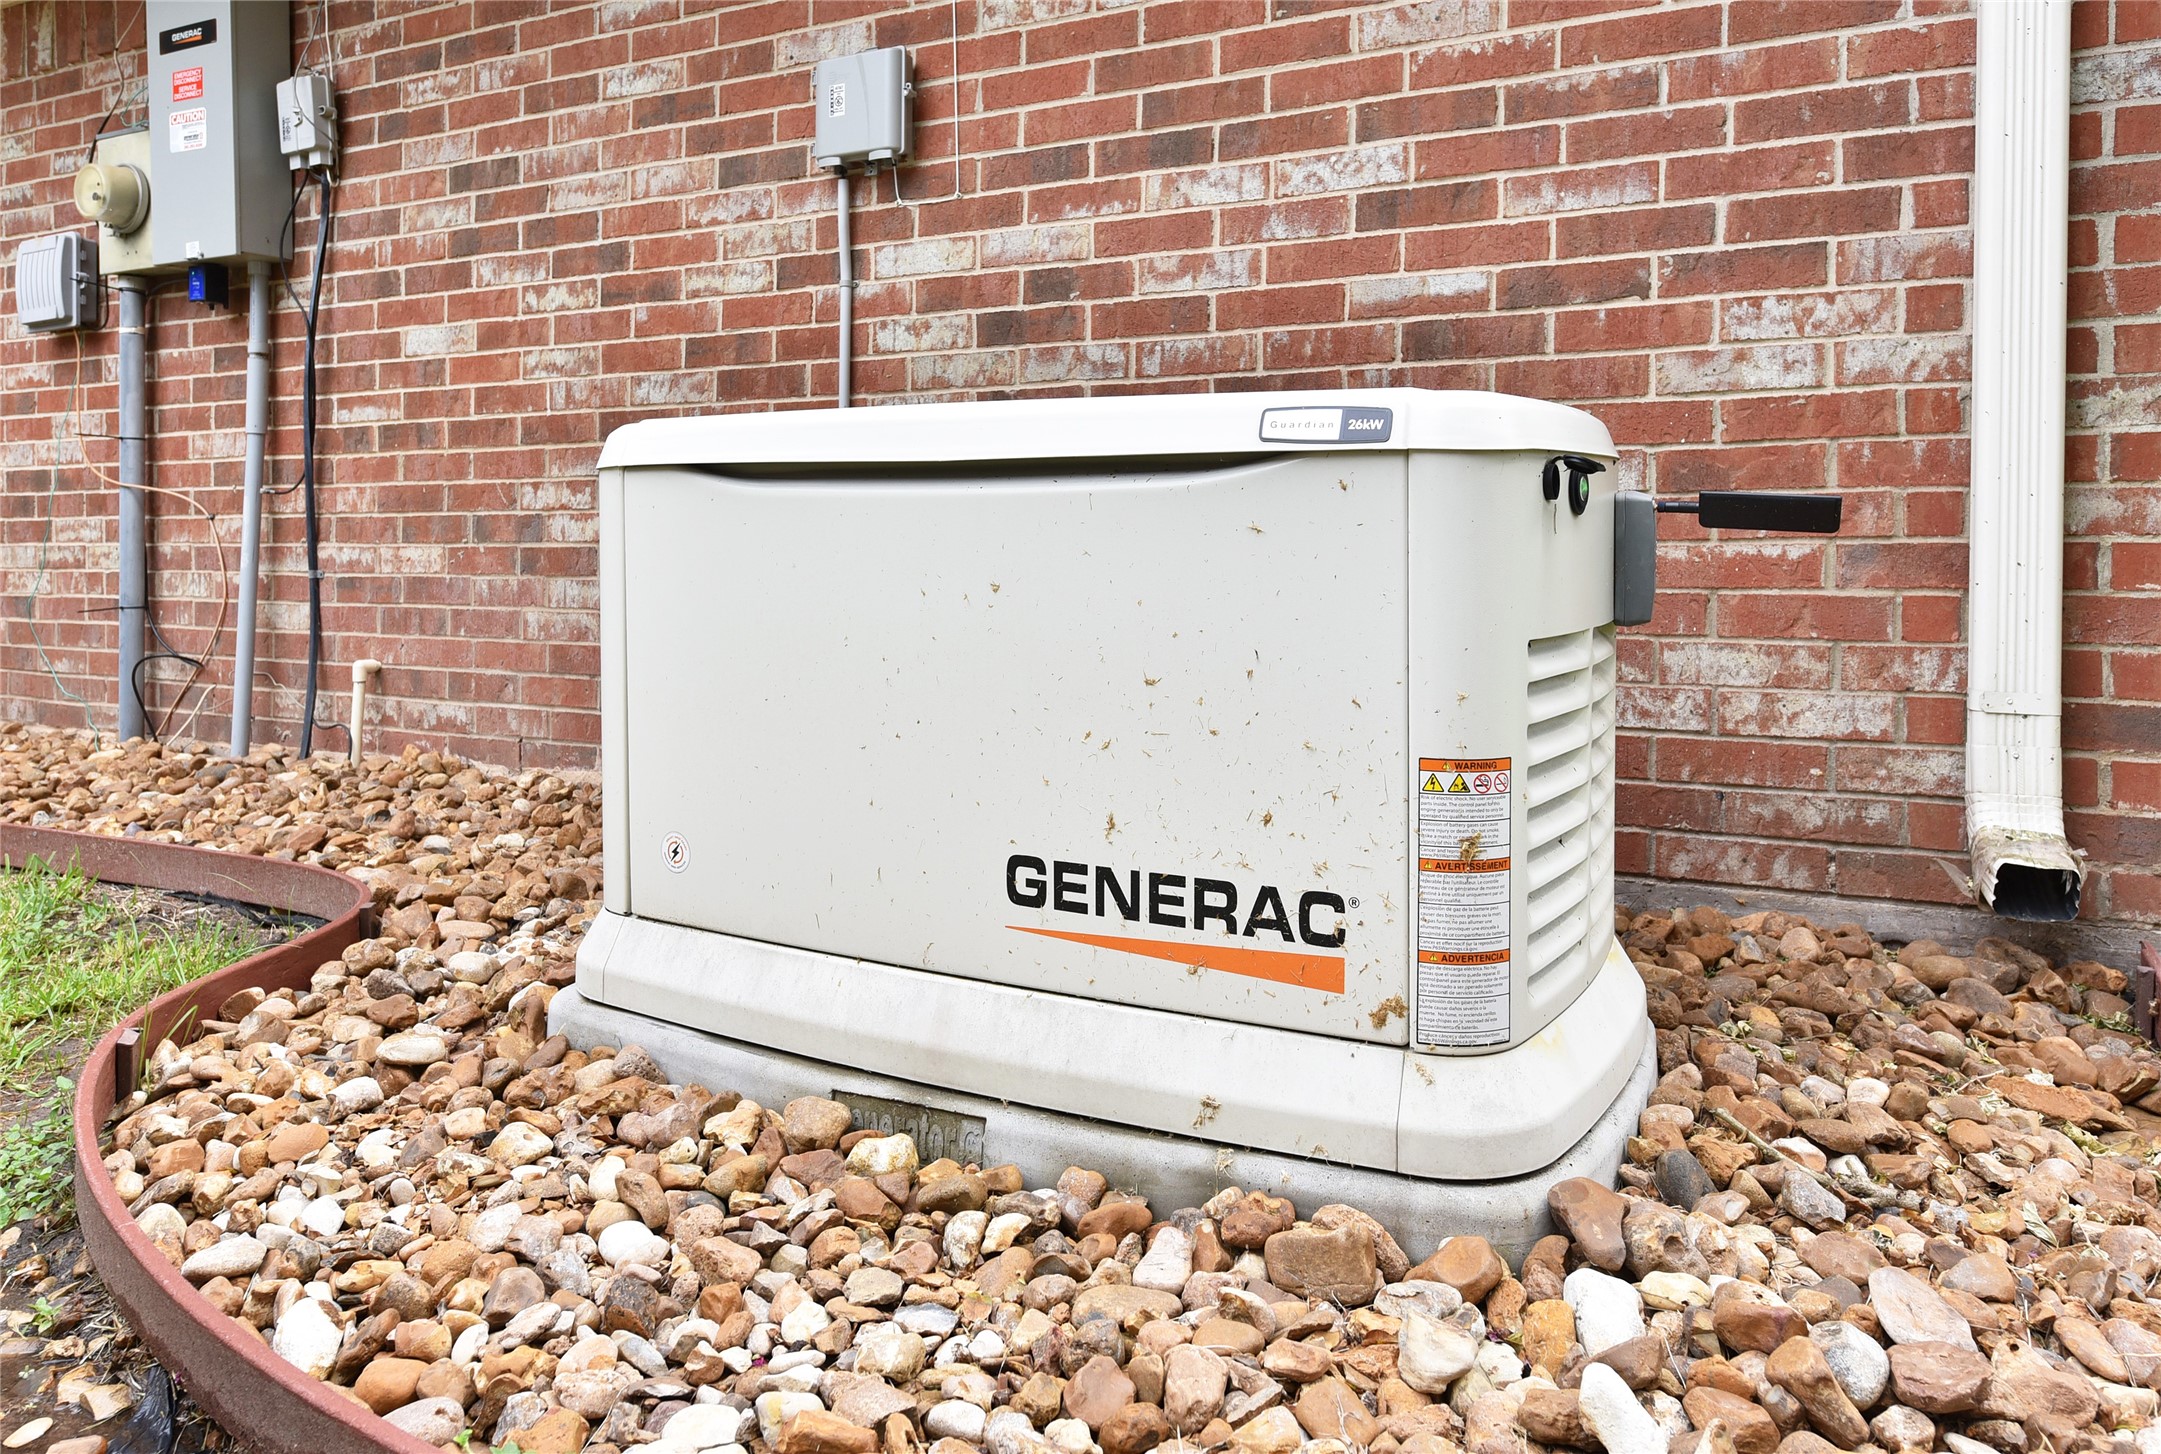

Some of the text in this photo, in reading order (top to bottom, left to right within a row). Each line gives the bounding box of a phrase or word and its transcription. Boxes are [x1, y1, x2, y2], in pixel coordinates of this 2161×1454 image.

[172, 28, 202, 41] GENERAC
[174, 69, 201, 79] EMERGENCY
[174, 76, 201, 86] DISCONNECT
[179, 83, 197, 93] SERVICE
[174, 89, 201, 100] DISCONNECT
[171, 110, 205, 125] CAUTION
[1270, 419, 1384, 430] Guardian 26kW
[1006, 854, 1346, 948] GENERAC
[1441, 953, 1504, 963] ADVERTENCIA
